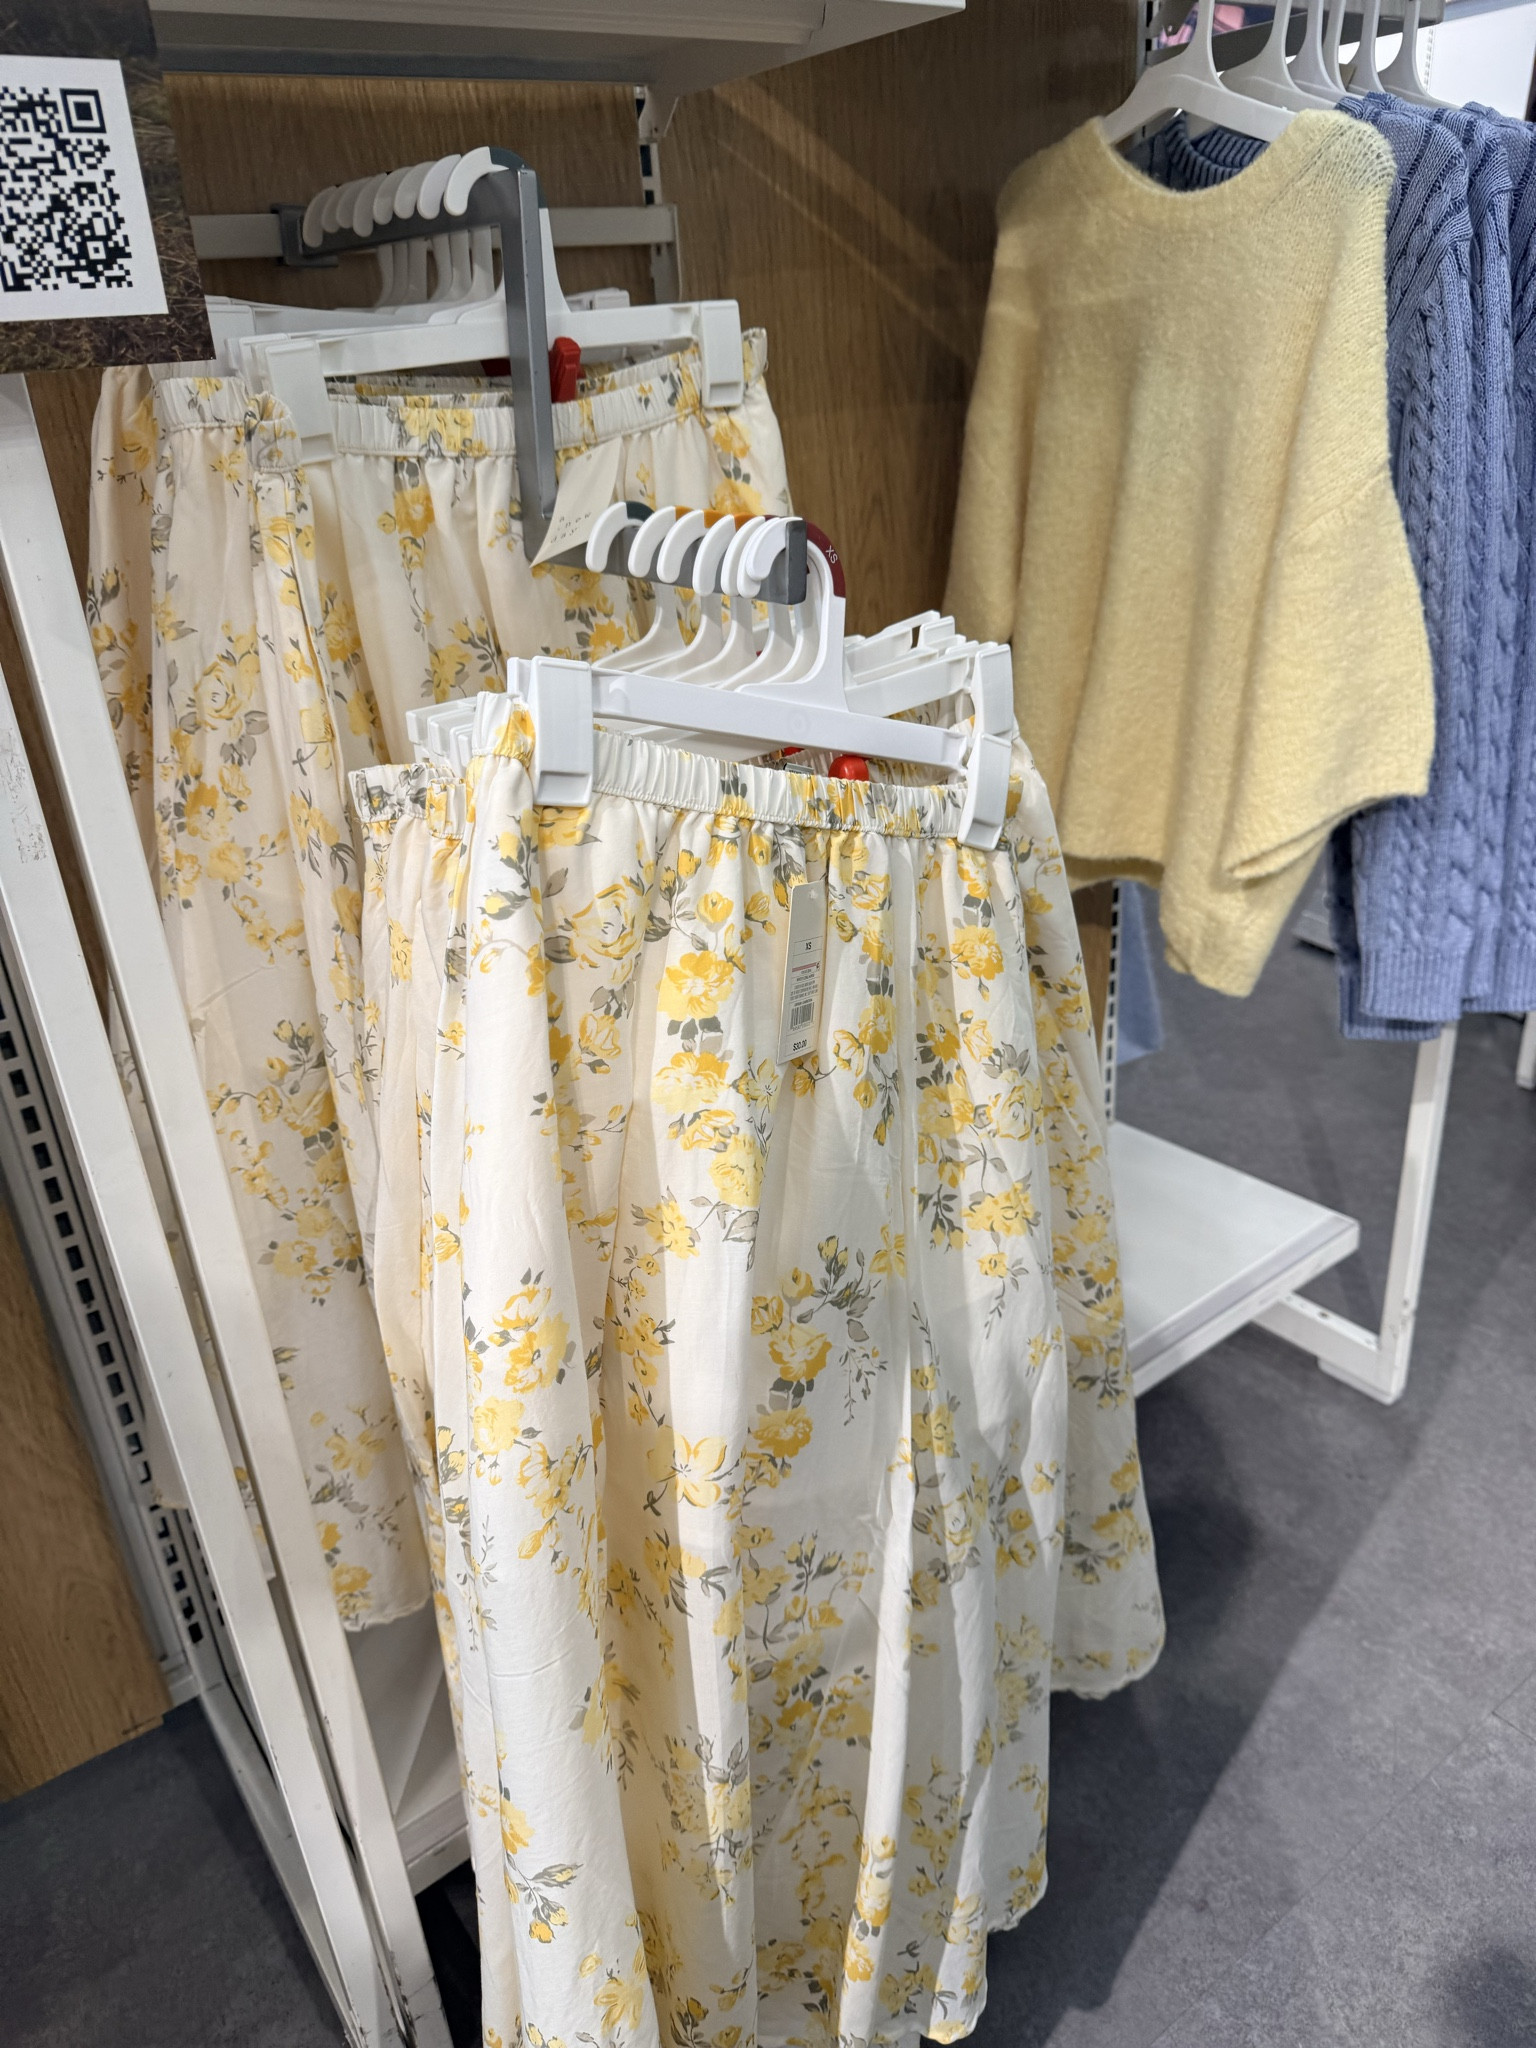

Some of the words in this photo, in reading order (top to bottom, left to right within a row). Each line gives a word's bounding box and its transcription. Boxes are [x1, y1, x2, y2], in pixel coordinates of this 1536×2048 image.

[825, 545, 838, 564] XS
[805, 941, 812, 951] XS
[793, 1039, 808, 1052] $30.00
